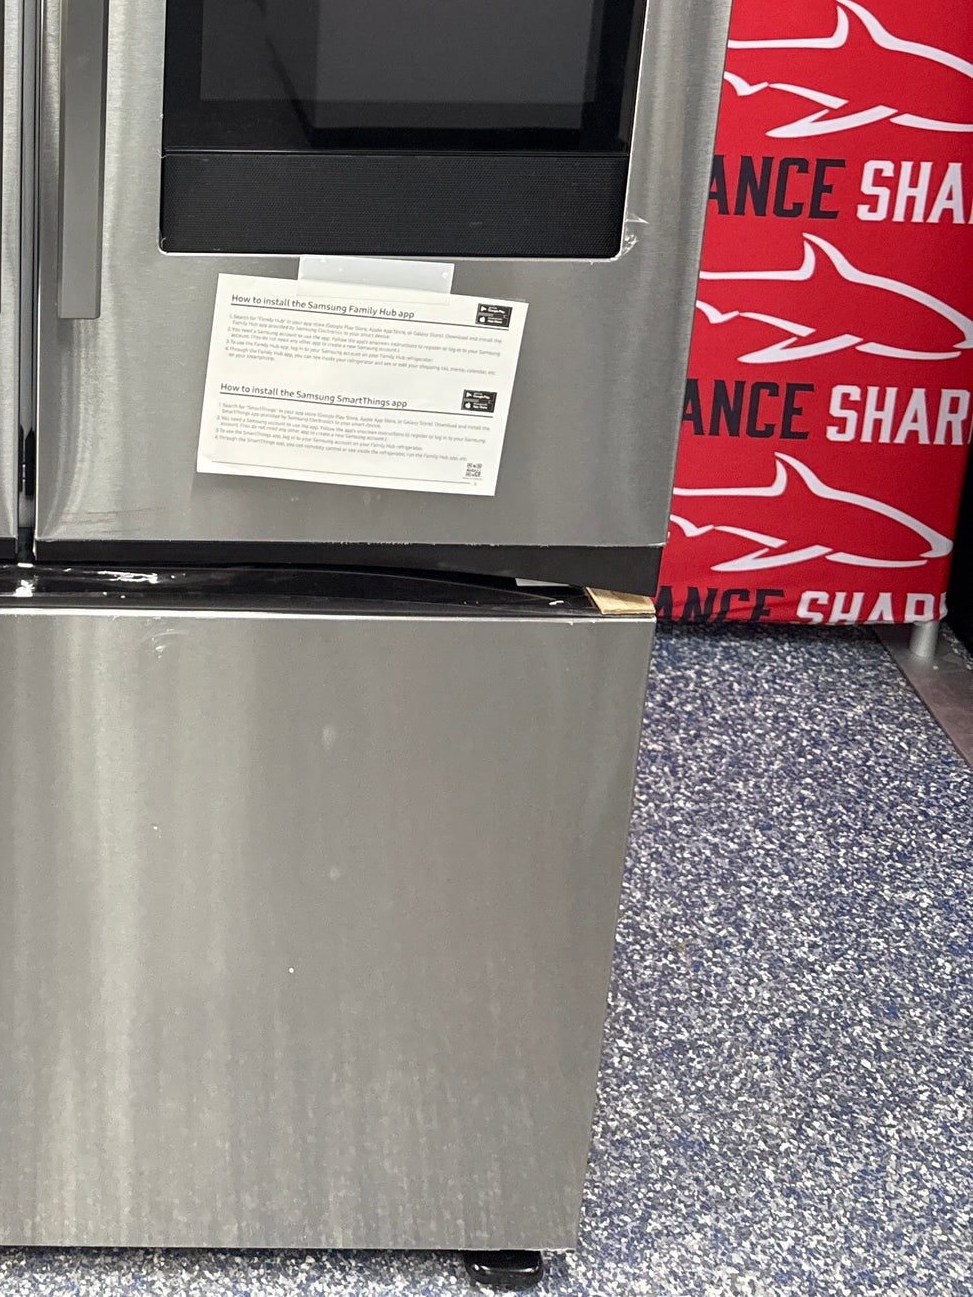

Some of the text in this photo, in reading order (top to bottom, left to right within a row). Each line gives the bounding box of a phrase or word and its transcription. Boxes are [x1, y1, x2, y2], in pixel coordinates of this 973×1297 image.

[707, 154, 973, 223] ANCE SHA
[231, 294, 251, 302] How
[263, 297, 290, 306] install
[291, 299, 306, 308] the
[307, 301, 347, 313] Samsung
[348, 305, 378, 316] Family
[378, 307, 397, 316] Hub
[397, 311, 414, 319] app
[220, 383, 240, 391] How
[251, 386, 278, 395] install
[280, 389, 295, 397] the
[296, 390, 335, 402] Samsung
[336, 394, 390, 407] SmartThings
[391, 400, 407, 408] app
[680, 378, 969, 444] ANCE SHAR
